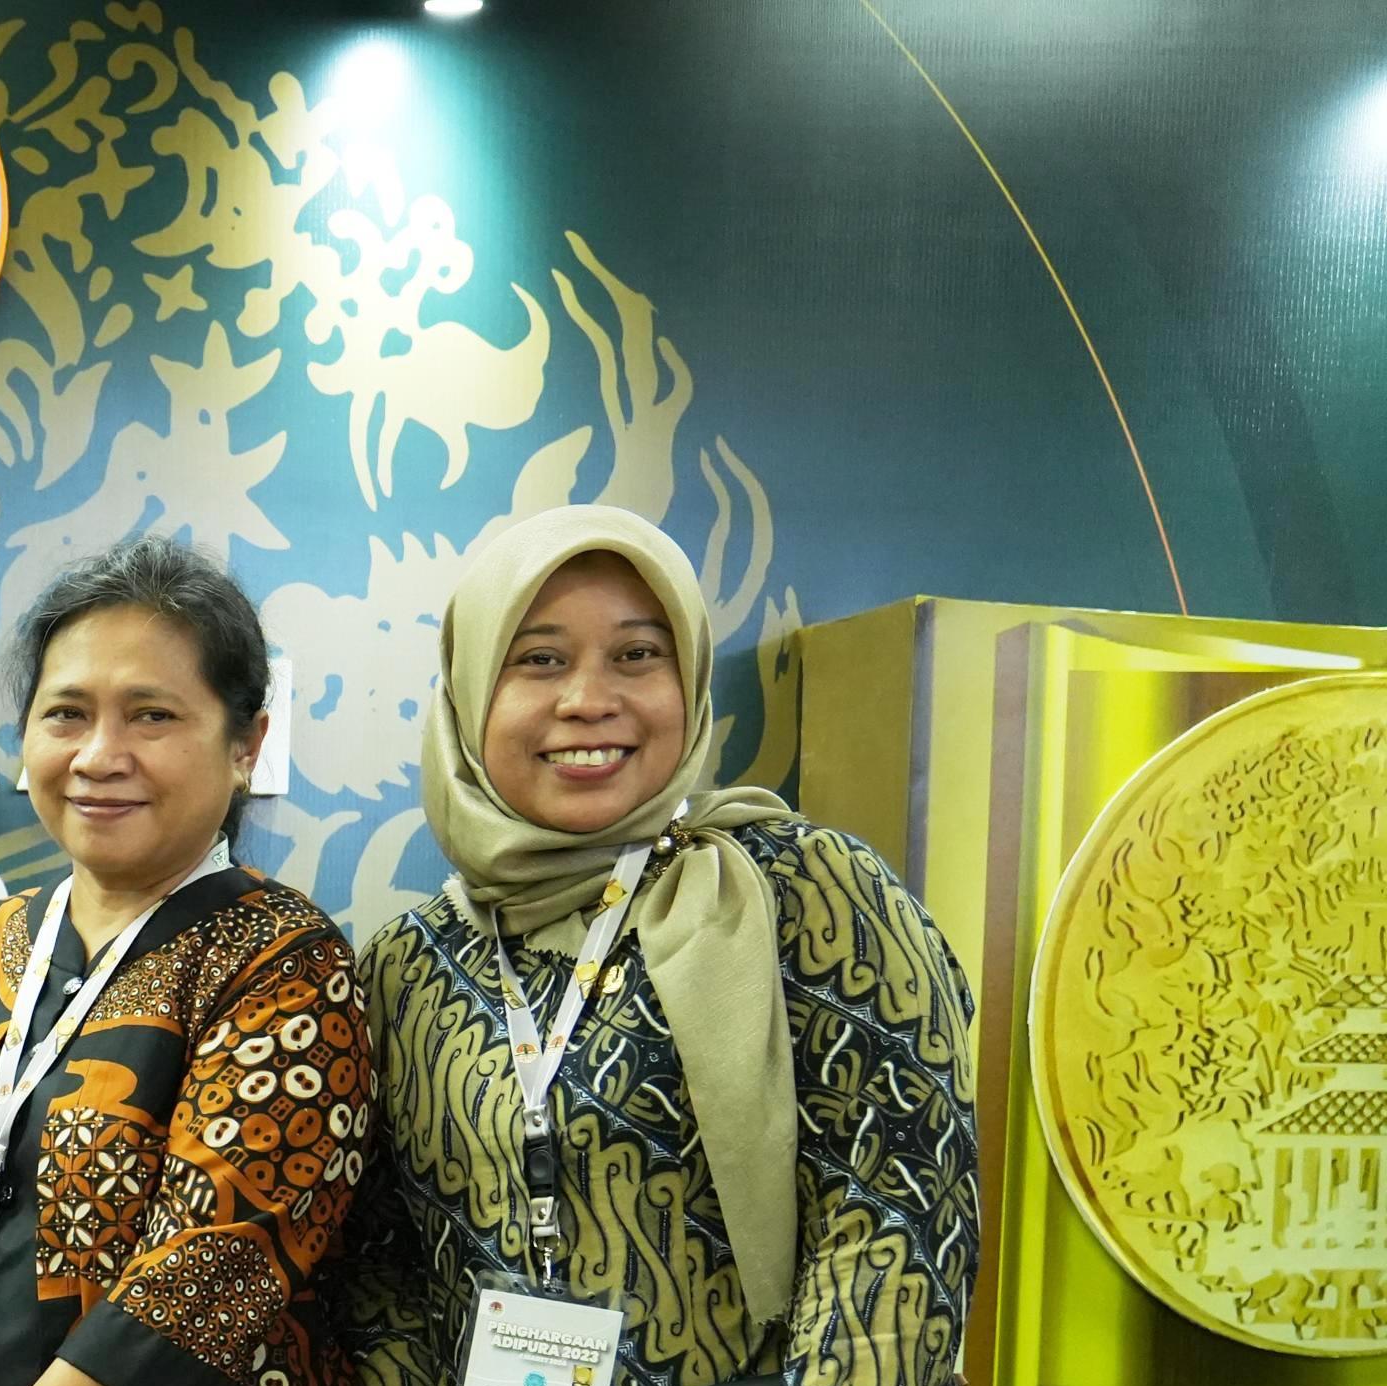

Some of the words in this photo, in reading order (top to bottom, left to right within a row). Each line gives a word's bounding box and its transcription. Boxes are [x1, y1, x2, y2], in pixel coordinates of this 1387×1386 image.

[487, 1320, 609, 1351] PENGHARGAAN
[491, 1334, 560, 1358] ADIPURA
[561, 1347, 601, 1364] 2023
